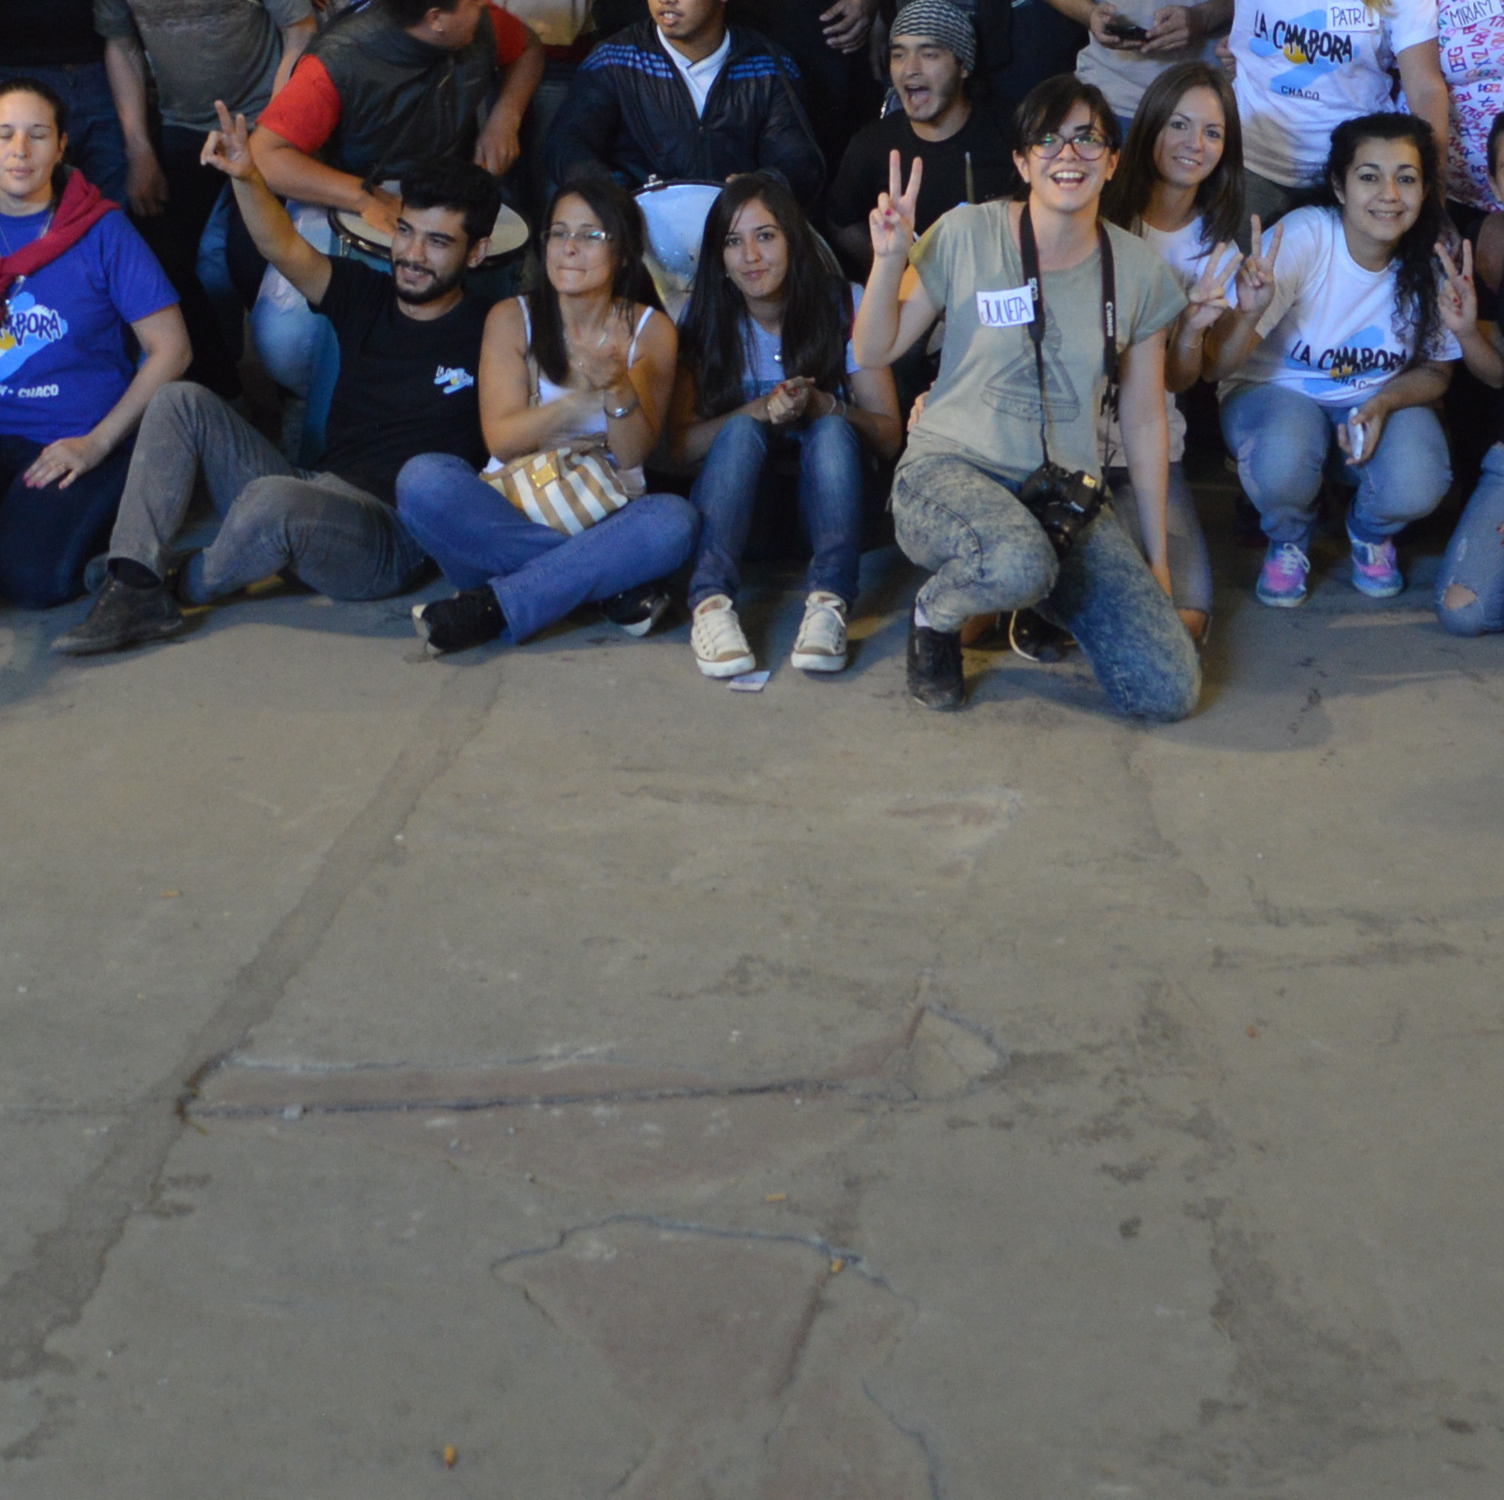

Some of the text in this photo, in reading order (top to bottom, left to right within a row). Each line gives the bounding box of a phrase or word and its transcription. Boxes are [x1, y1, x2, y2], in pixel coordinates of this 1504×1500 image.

[1330, 6, 1375, 27] PATRI
[1254, 9, 1354, 66] LA CAMPORA
[1281, 85, 1320, 101] CHACO
[981, 296, 1031, 324] JULIETA
[1290, 340, 1311, 367] LA
[18, 384, 60, 398] CHACO
